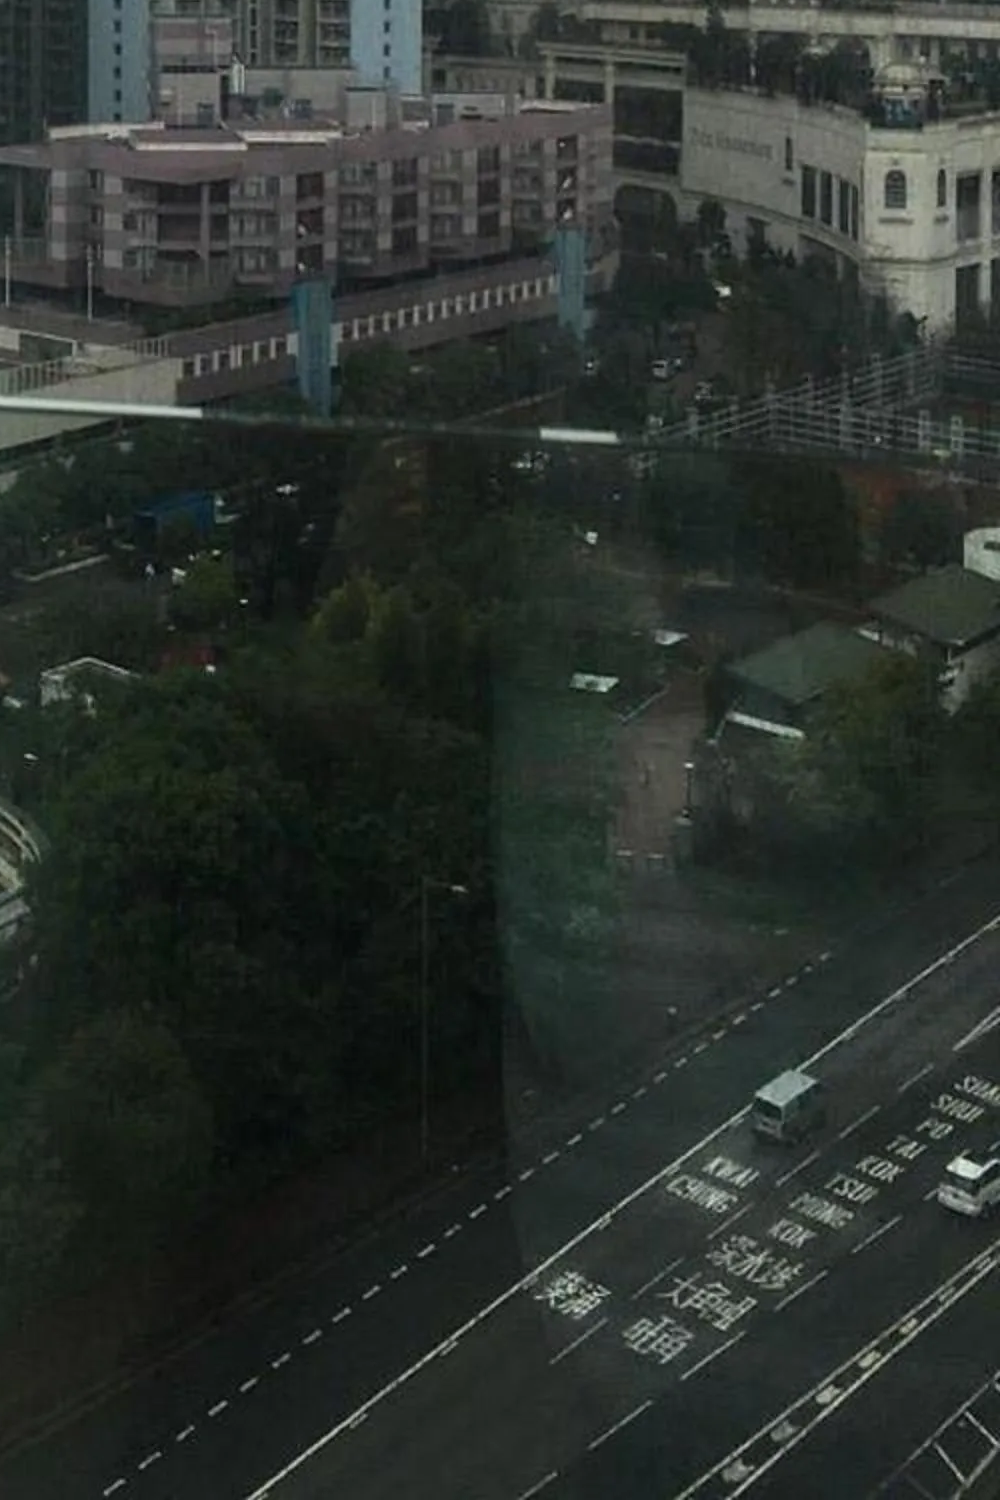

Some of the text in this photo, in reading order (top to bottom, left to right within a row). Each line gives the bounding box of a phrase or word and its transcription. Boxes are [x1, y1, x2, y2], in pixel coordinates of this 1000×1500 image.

[930, 1094, 986, 1124] SHUI
[915, 1116, 956, 1141] PO
[884, 1134, 929, 1161] TAI
[701, 1155, 761, 1190] KWAI
[854, 1154, 907, 1184] KOK
[823, 1172, 881, 1205] TSUI
[788, 1191, 856, 1231] MONG
[767, 1217, 818, 1250] KOK
